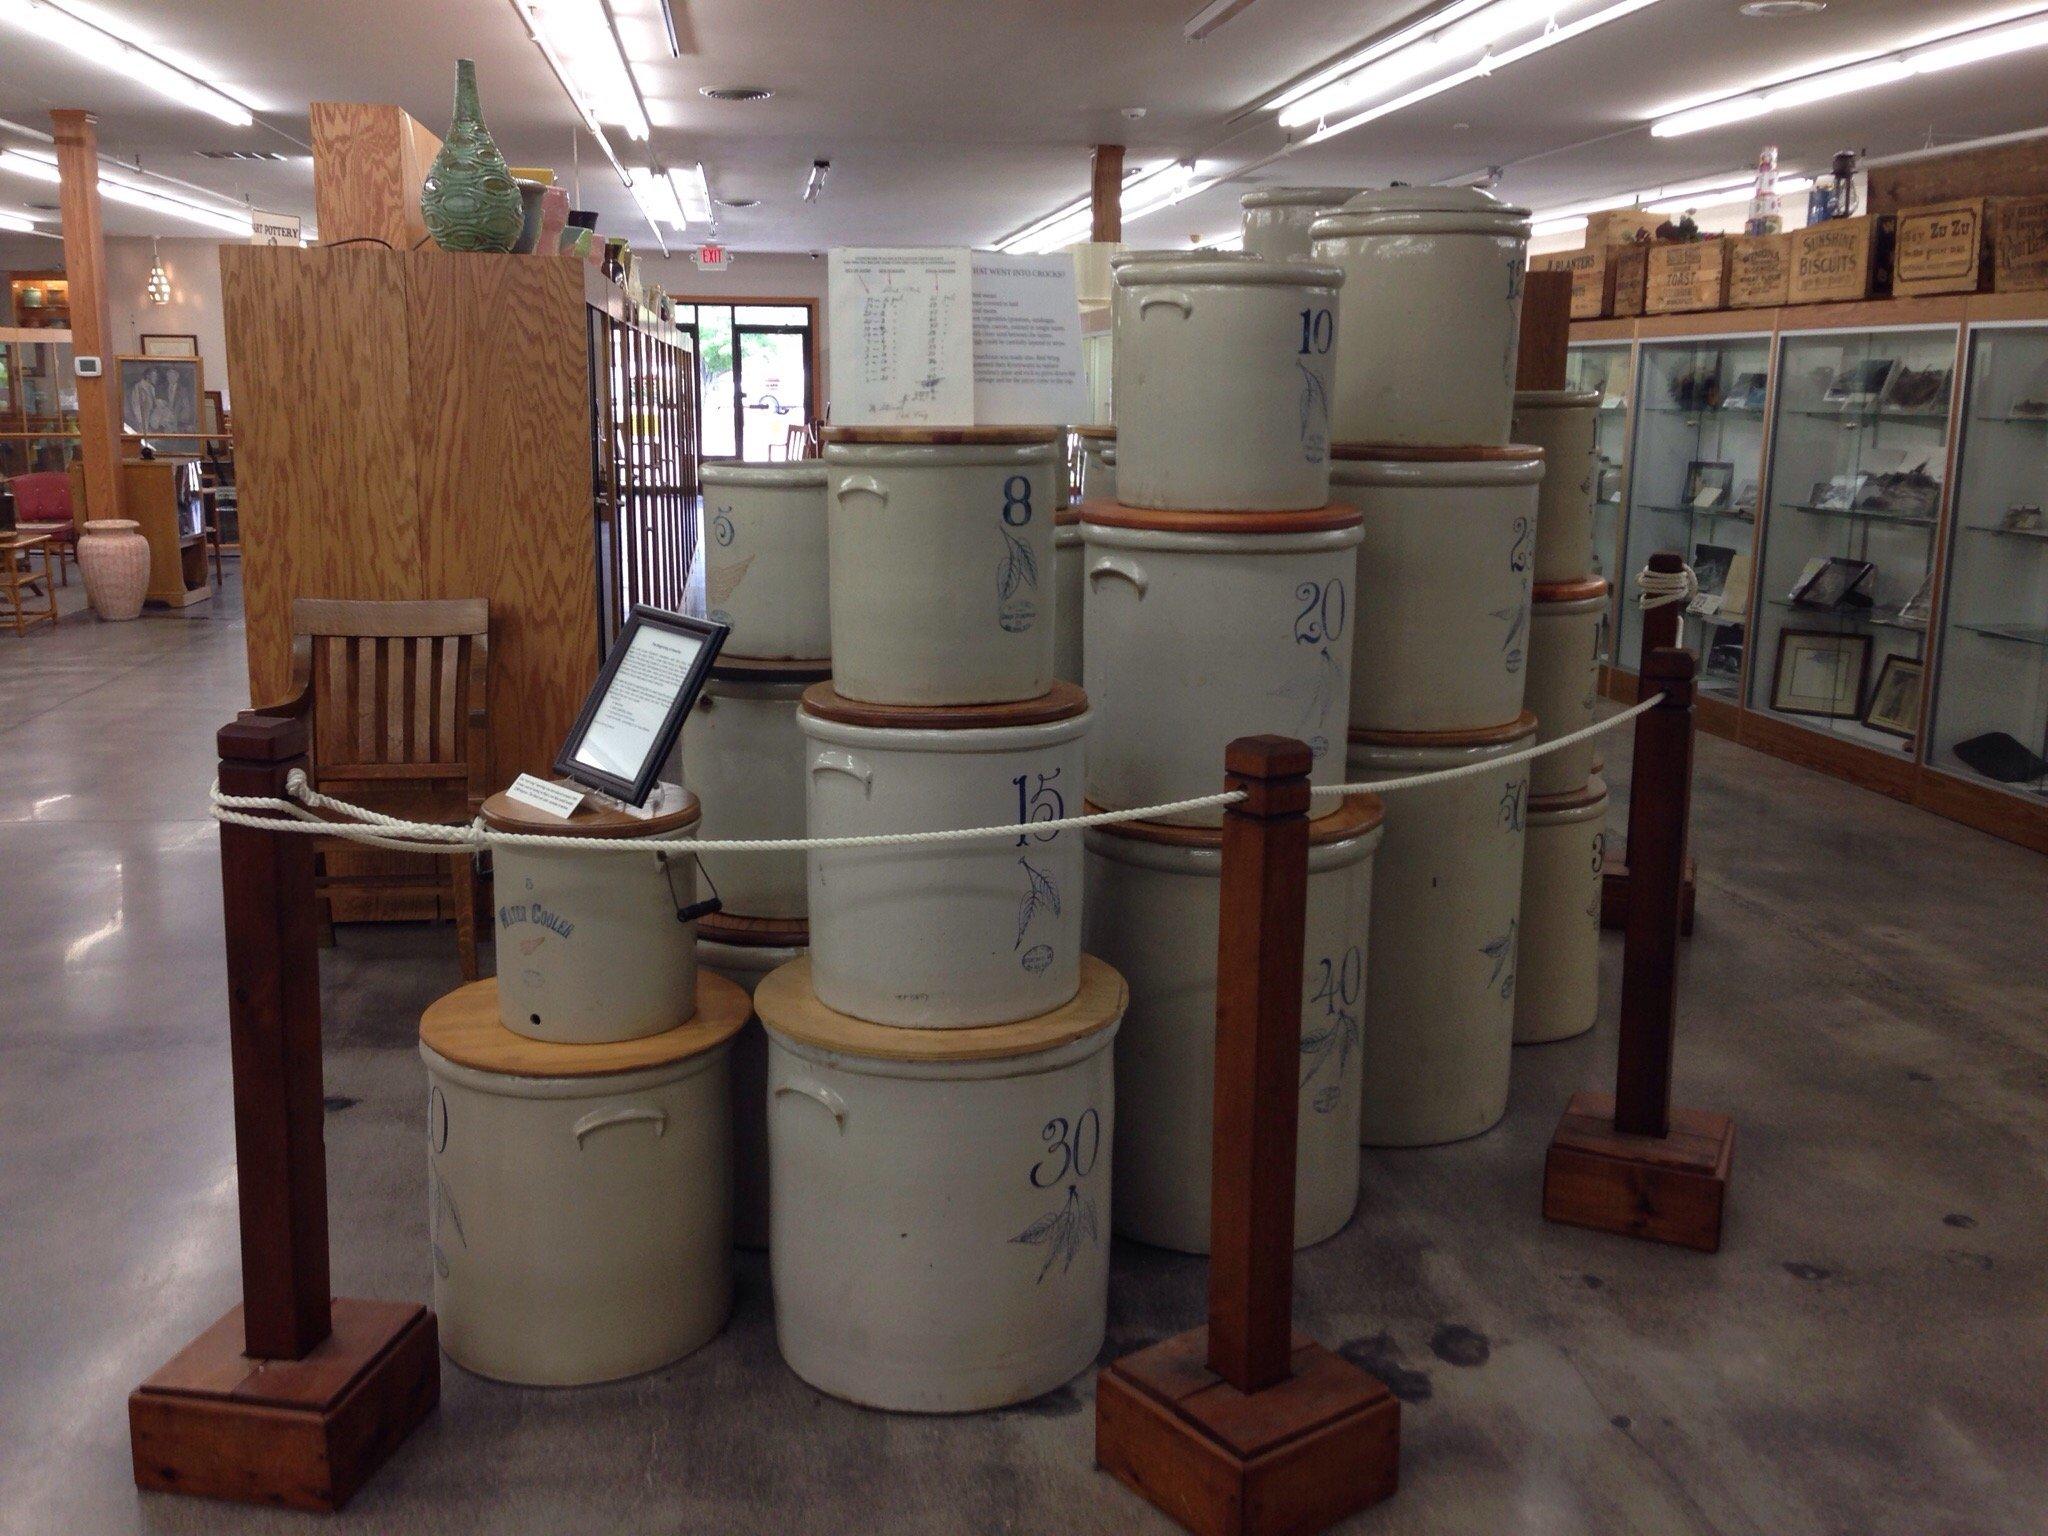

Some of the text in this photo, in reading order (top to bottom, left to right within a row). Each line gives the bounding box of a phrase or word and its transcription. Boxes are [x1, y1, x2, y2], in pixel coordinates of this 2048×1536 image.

[265, 225, 299, 238] POTTERY
[1951, 219, 1971, 237] Zu
[702, 249, 722, 263] EXIT
[1800, 254, 1857, 277] BISCUITS
[1298, 308, 1333, 355] 10
[1003, 475, 1032, 526] 8
[713, 506, 735, 547] 5
[1295, 578, 1345, 645] 20
[1013, 767, 1064, 847] 15
[1311, 946, 1361, 1016] 40
[1030, 1108, 1100, 1188] 30
